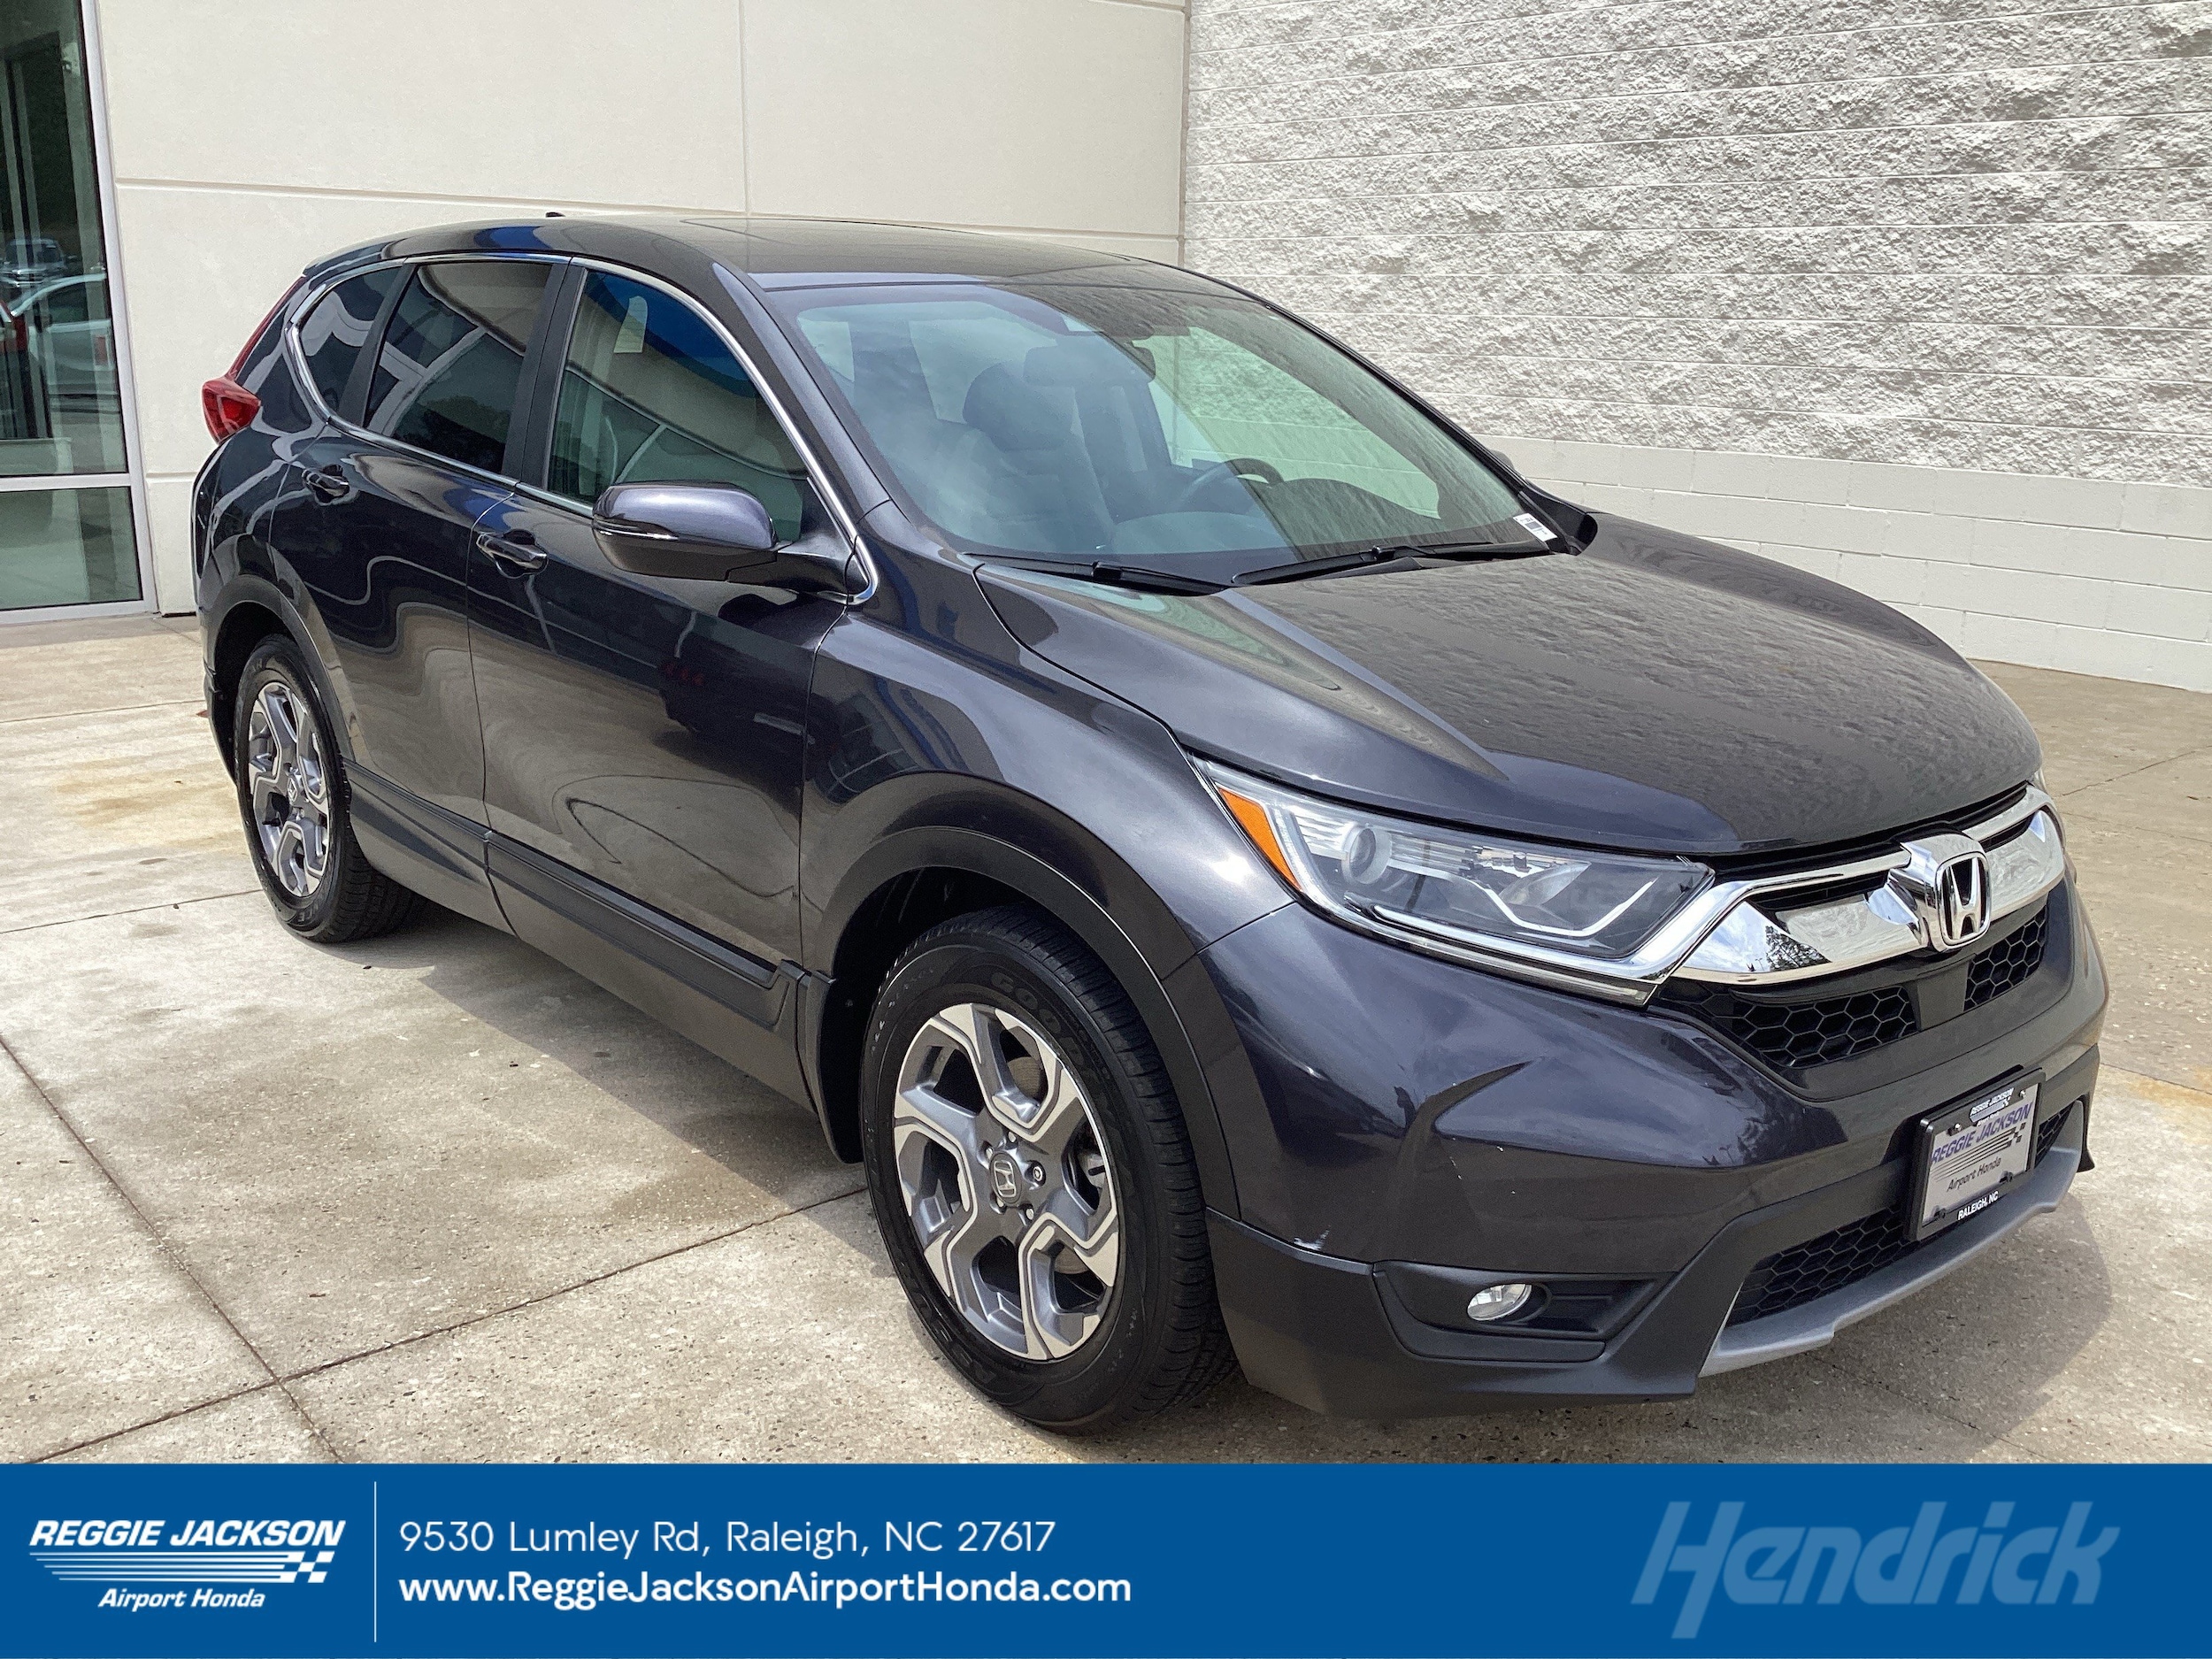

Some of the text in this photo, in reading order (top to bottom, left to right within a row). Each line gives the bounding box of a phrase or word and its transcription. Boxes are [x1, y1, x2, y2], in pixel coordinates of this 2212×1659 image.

[1931, 1130, 1977, 1163] REGGIE
[1976, 1102, 2033, 1143] JACKSON
[1947, 1156, 2001, 1193] Airport Honda
[1957, 1190, 2000, 1220] RALEIGH, NC
